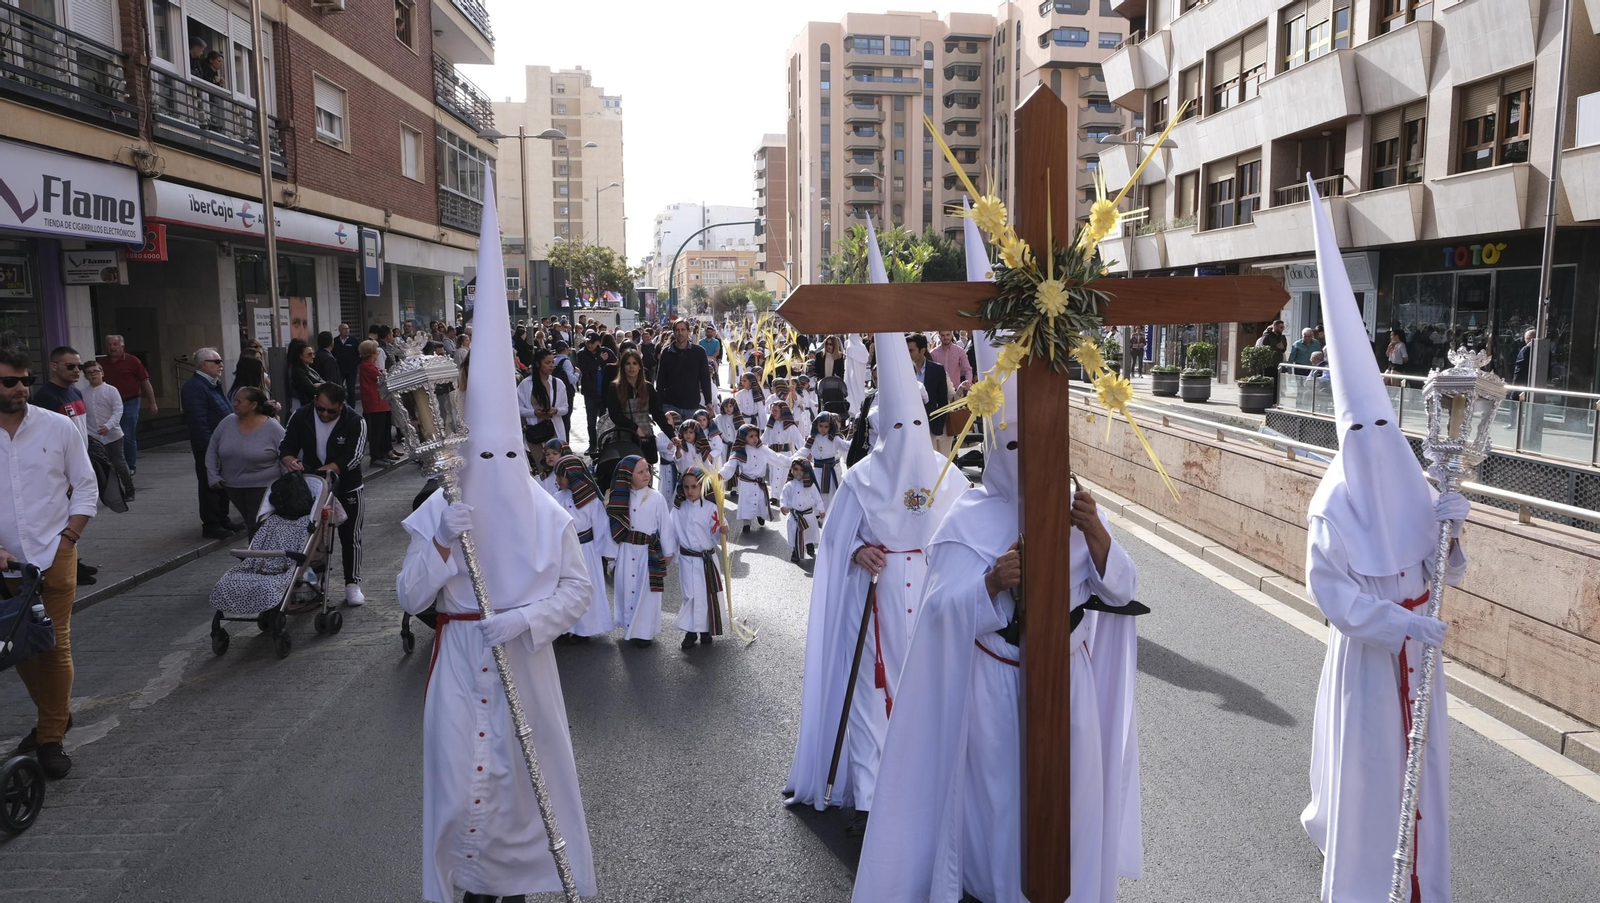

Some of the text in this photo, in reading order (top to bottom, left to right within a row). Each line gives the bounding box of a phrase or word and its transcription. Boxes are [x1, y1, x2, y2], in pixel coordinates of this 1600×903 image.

[42, 174, 135, 226] Flame
[188, 194, 234, 222] iberCaja
[44, 218, 64, 229] TIENDA
[64, 221, 72, 230] DE
[72, 222, 103, 234] CIGARRILLOS
